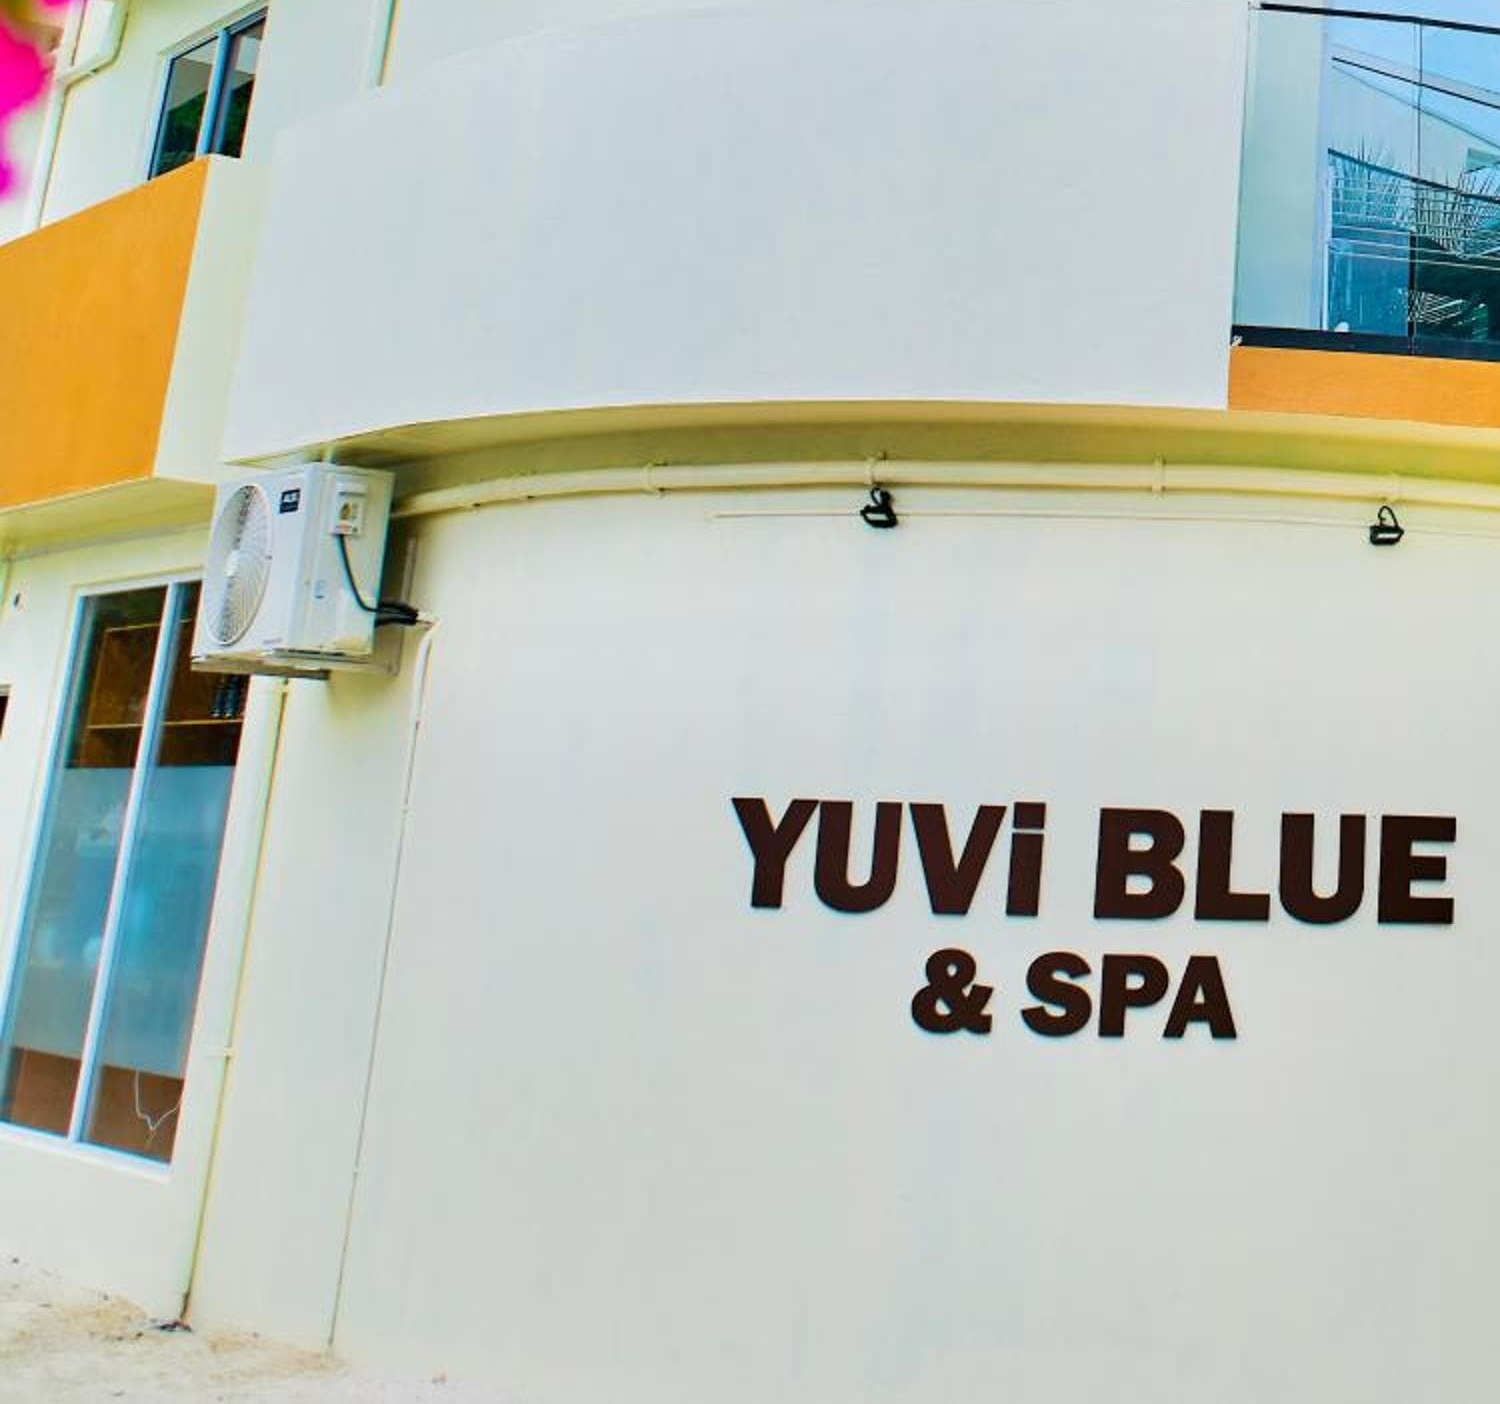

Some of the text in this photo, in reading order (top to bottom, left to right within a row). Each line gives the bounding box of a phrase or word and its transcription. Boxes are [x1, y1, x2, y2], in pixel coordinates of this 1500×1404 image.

[732, 798, 1456, 925] YUVi BLUE
[911, 949, 1237, 1039] & SPA
